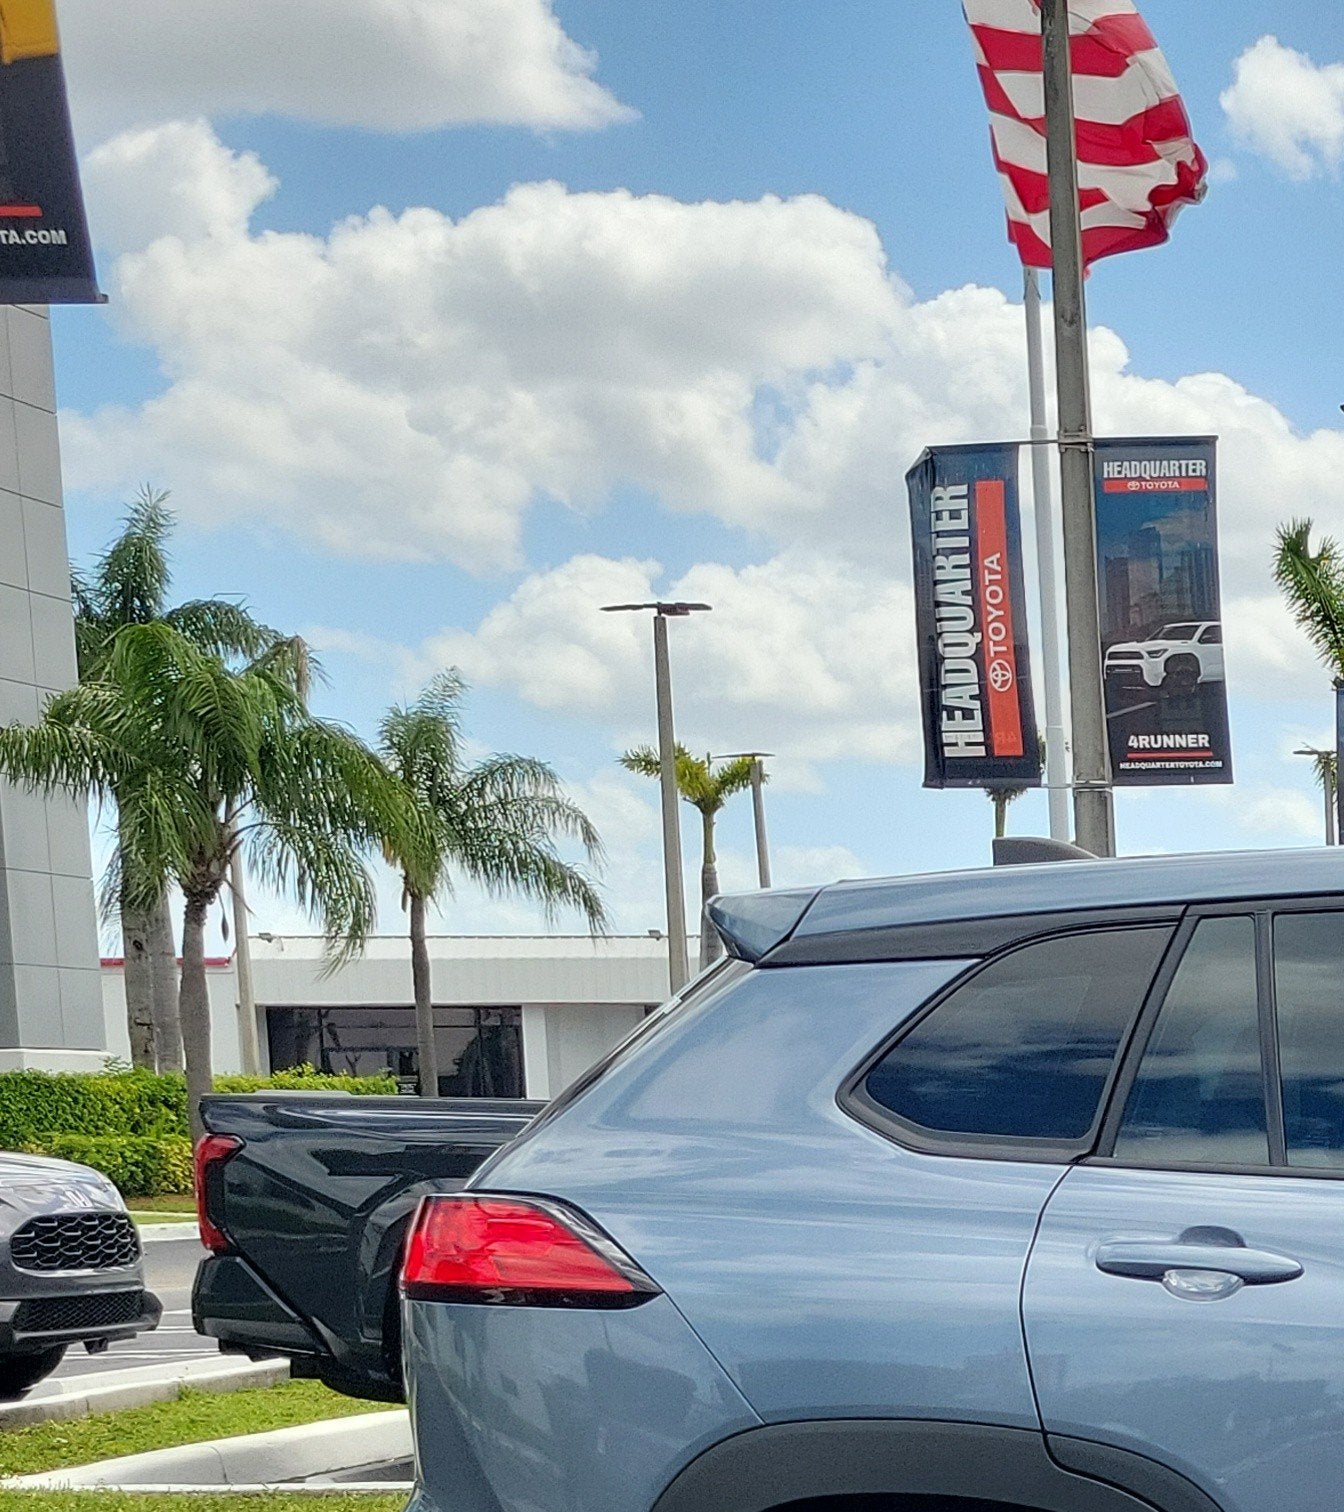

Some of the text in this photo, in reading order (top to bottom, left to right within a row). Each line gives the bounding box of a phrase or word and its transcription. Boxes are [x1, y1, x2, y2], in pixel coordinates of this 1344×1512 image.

[1103, 459, 1207, 479] HEADQUARTER
[1141, 481, 1180, 490] TOYOTA
[984, 552, 1007, 658] TOYOTA
[930, 483, 988, 758] HEADQUARTER
[1128, 734, 1210, 748] 4RUNNER
